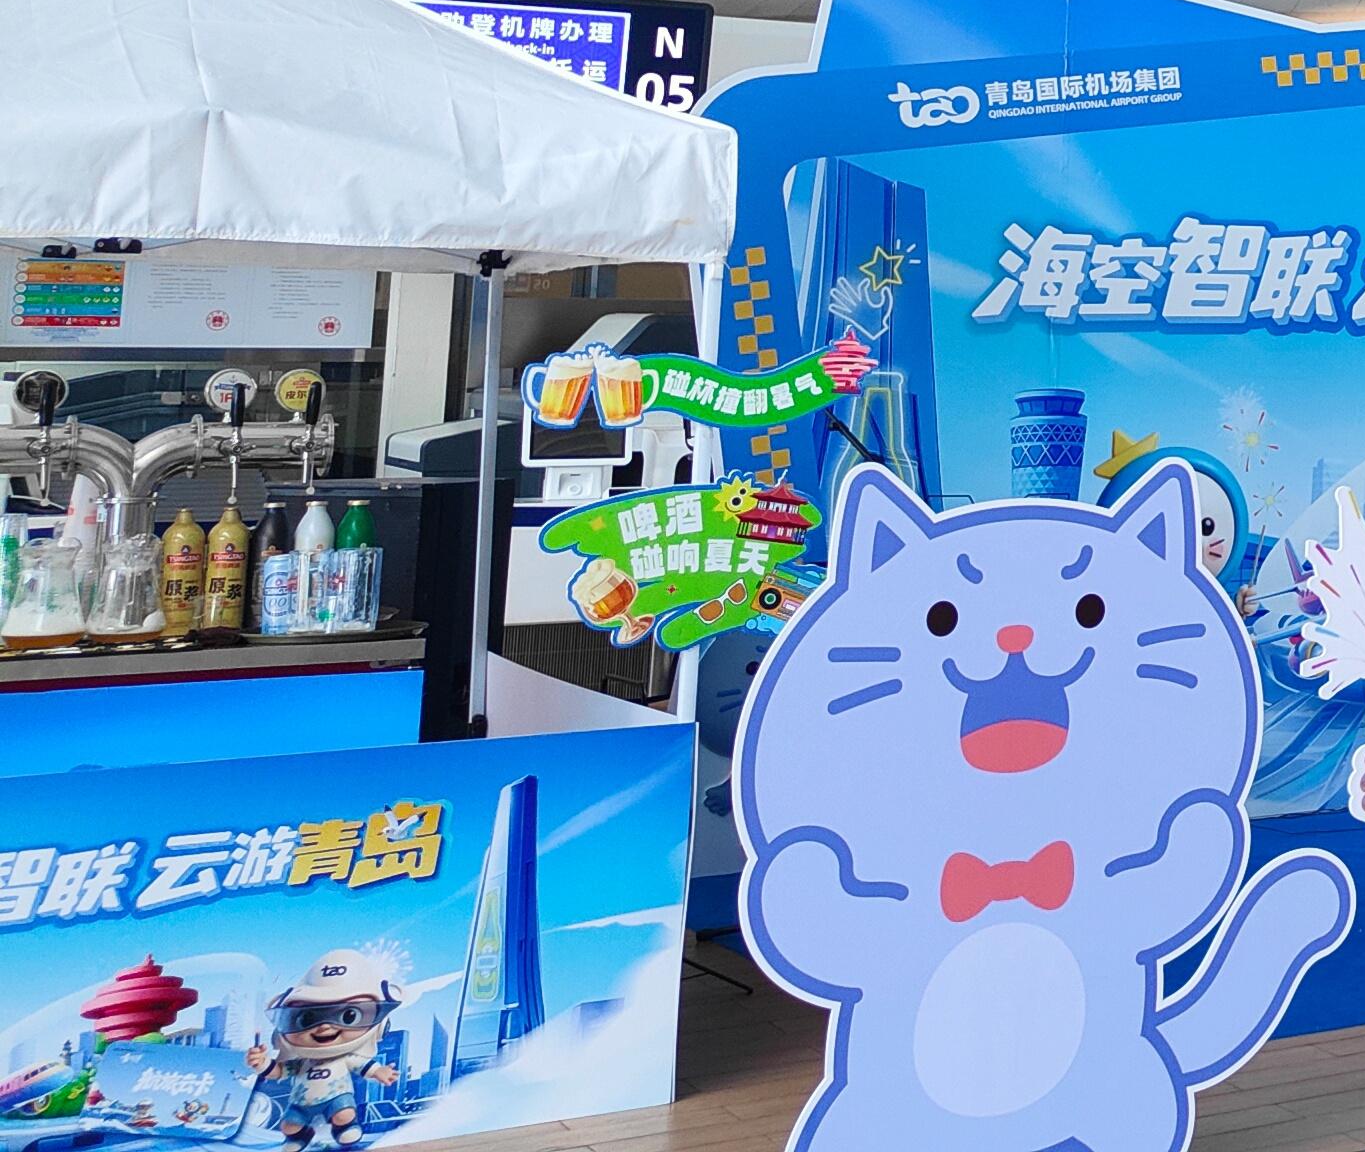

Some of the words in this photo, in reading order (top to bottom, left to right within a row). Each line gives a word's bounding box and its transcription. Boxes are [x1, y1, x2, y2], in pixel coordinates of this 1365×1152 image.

[654, 27, 685, 59] N
[636, 72, 695, 113] 05
[888, 82, 980, 128] tao
[985, 66, 1181, 106] 青岛国际机场集团
[988, 106, 1035, 119] QINGDAO
[1035, 99, 1110, 115] INTERNATIONAL
[1110, 95, 1150, 108] AIRPORT
[1150, 92, 1183, 103] GROUP
[972, 217, 1349, 325] 海空智联
[662, 368, 823, 416] 碰杯撞翻暑气
[617, 493, 704, 544] 啤酒
[629, 537, 771, 581] 碰响夏天
[137, 802, 444, 909] 云游青岛
